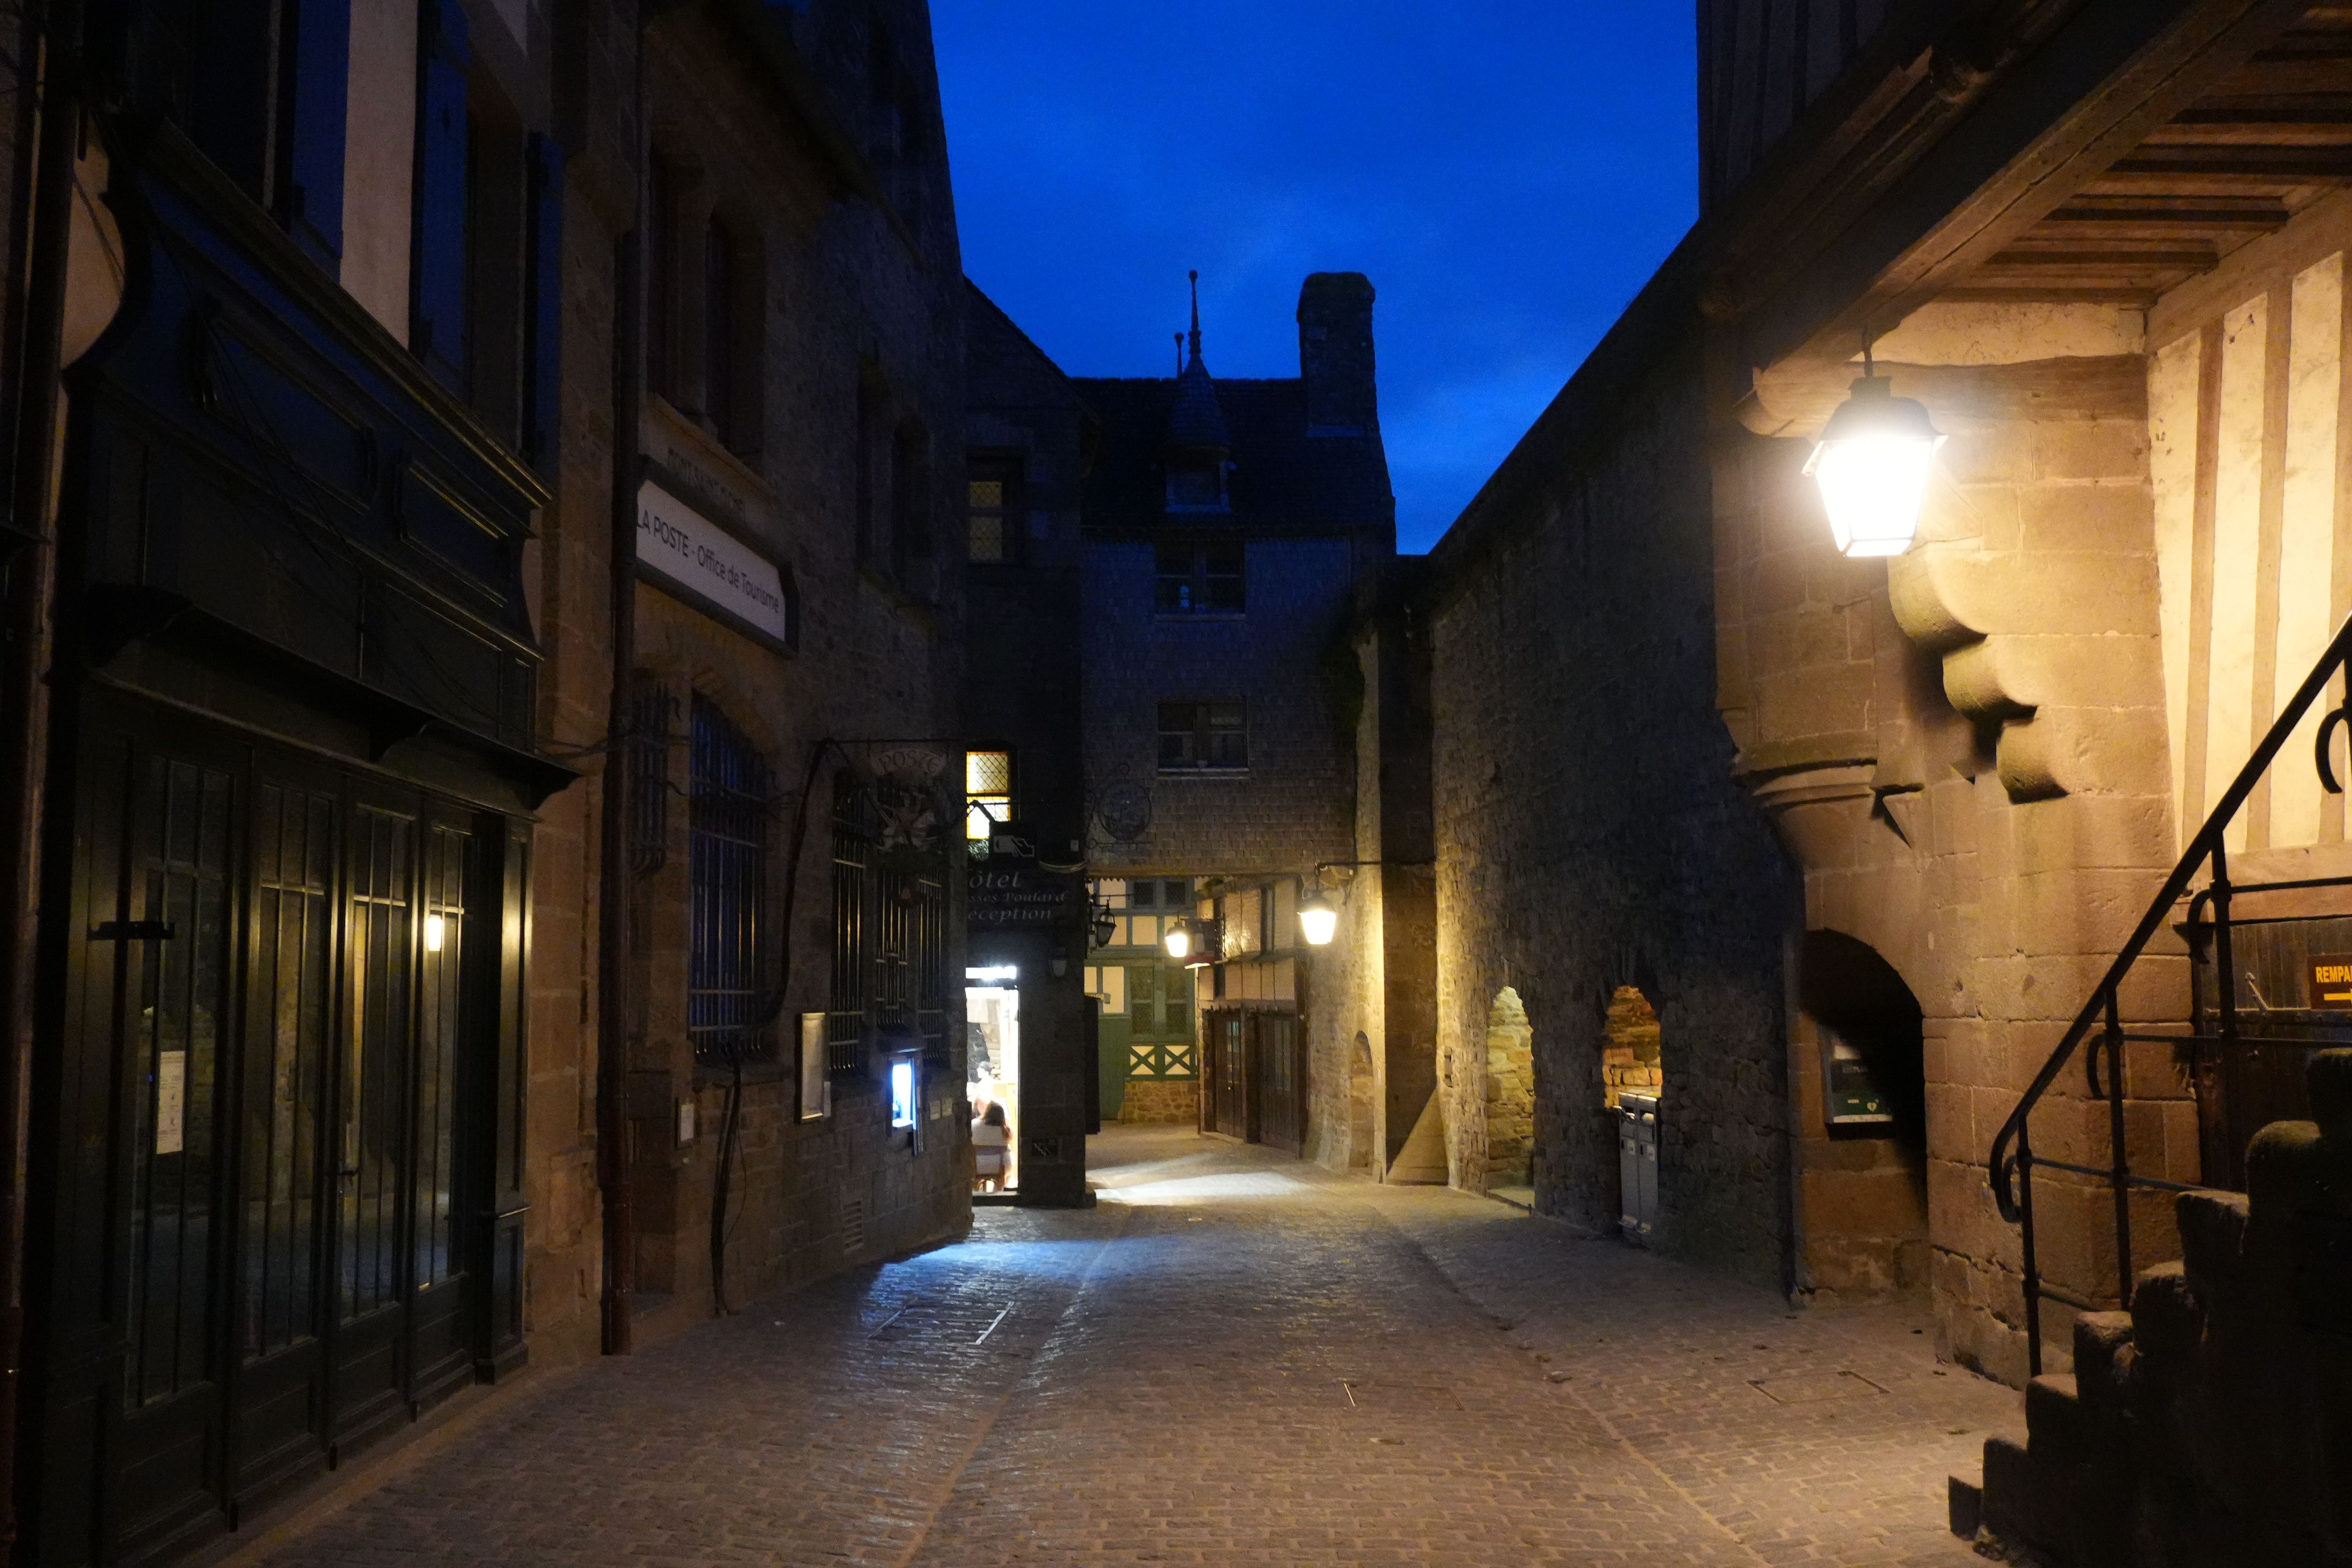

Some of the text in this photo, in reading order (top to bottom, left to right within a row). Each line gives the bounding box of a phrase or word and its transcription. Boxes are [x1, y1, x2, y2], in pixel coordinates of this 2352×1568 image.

[654, 515, 689, 558] POSTE
[697, 545, 725, 580] Office
[728, 565, 739, 589] de
[741, 572, 779, 614] Tourisme
[969, 870, 1021, 888] ôtel
[1003, 890, 1067, 903] Poulard
[968, 908, 1051, 925] eception
[2316, 966, 2352, 983] REMPA
